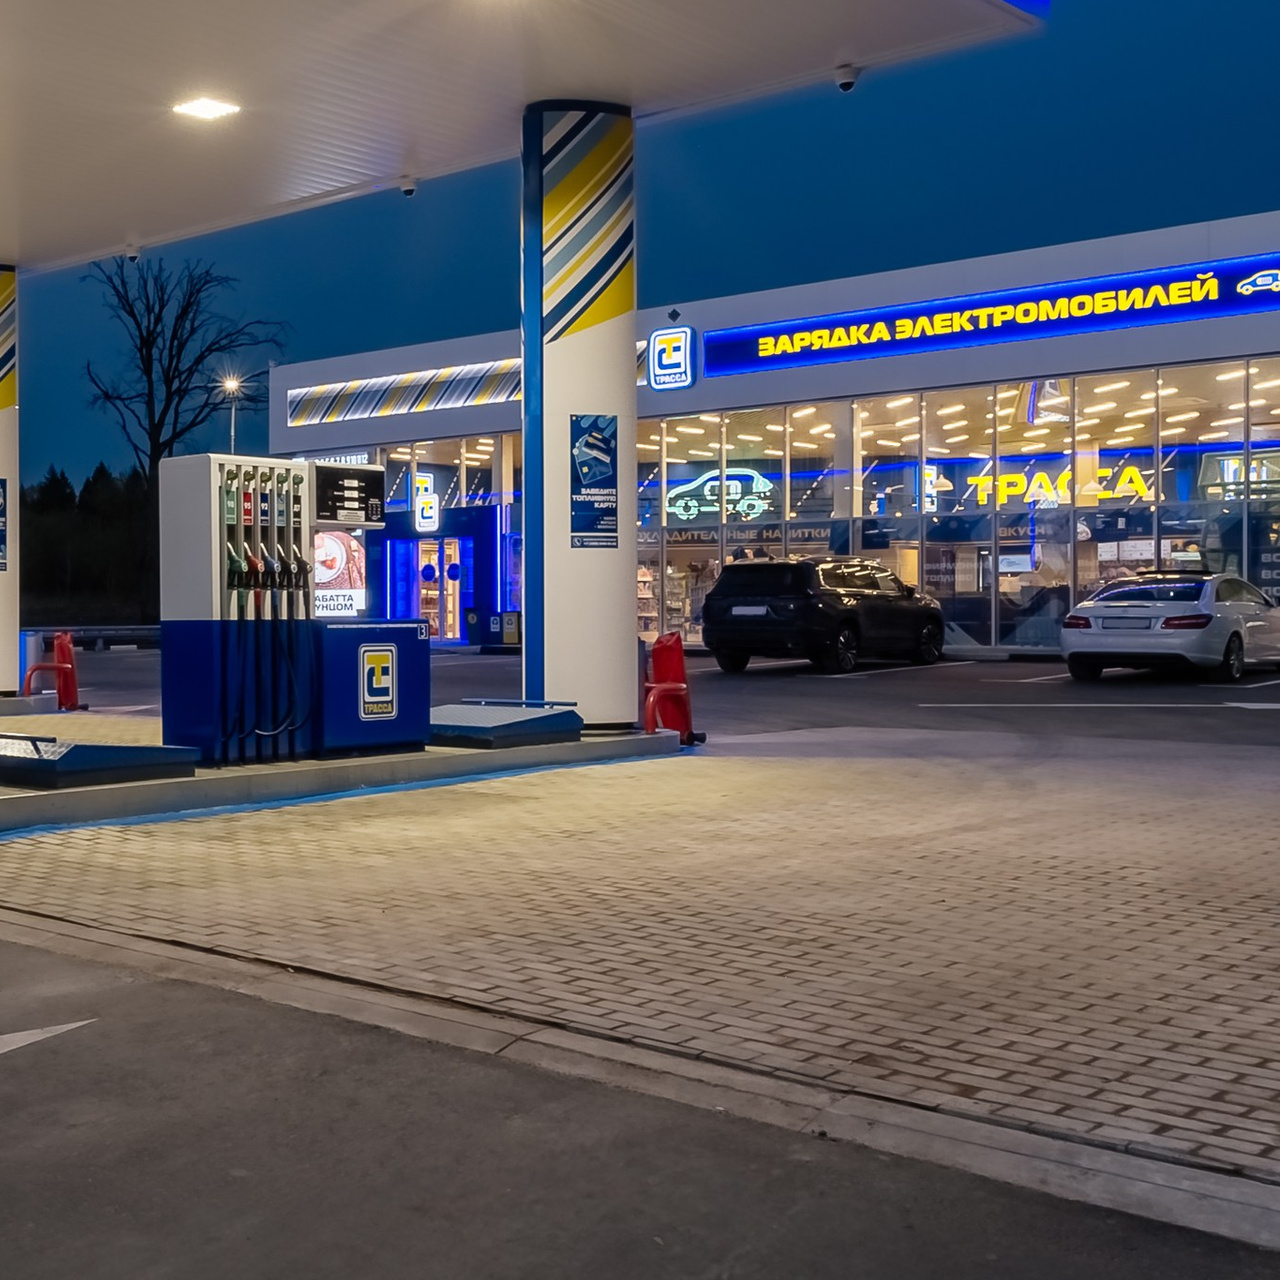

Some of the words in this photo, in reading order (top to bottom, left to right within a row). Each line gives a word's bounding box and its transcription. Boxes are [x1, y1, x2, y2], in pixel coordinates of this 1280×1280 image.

[758, 322, 891, 357] ЗАРЯДКА
[895, 272, 1219, 339] ЭЛЕКТРОМОБИЛЕЙ
[655, 373, 687, 384] ТРАССА
[420, 625, 426, 638] 3
[364, 703, 392, 714] ТРАССА
